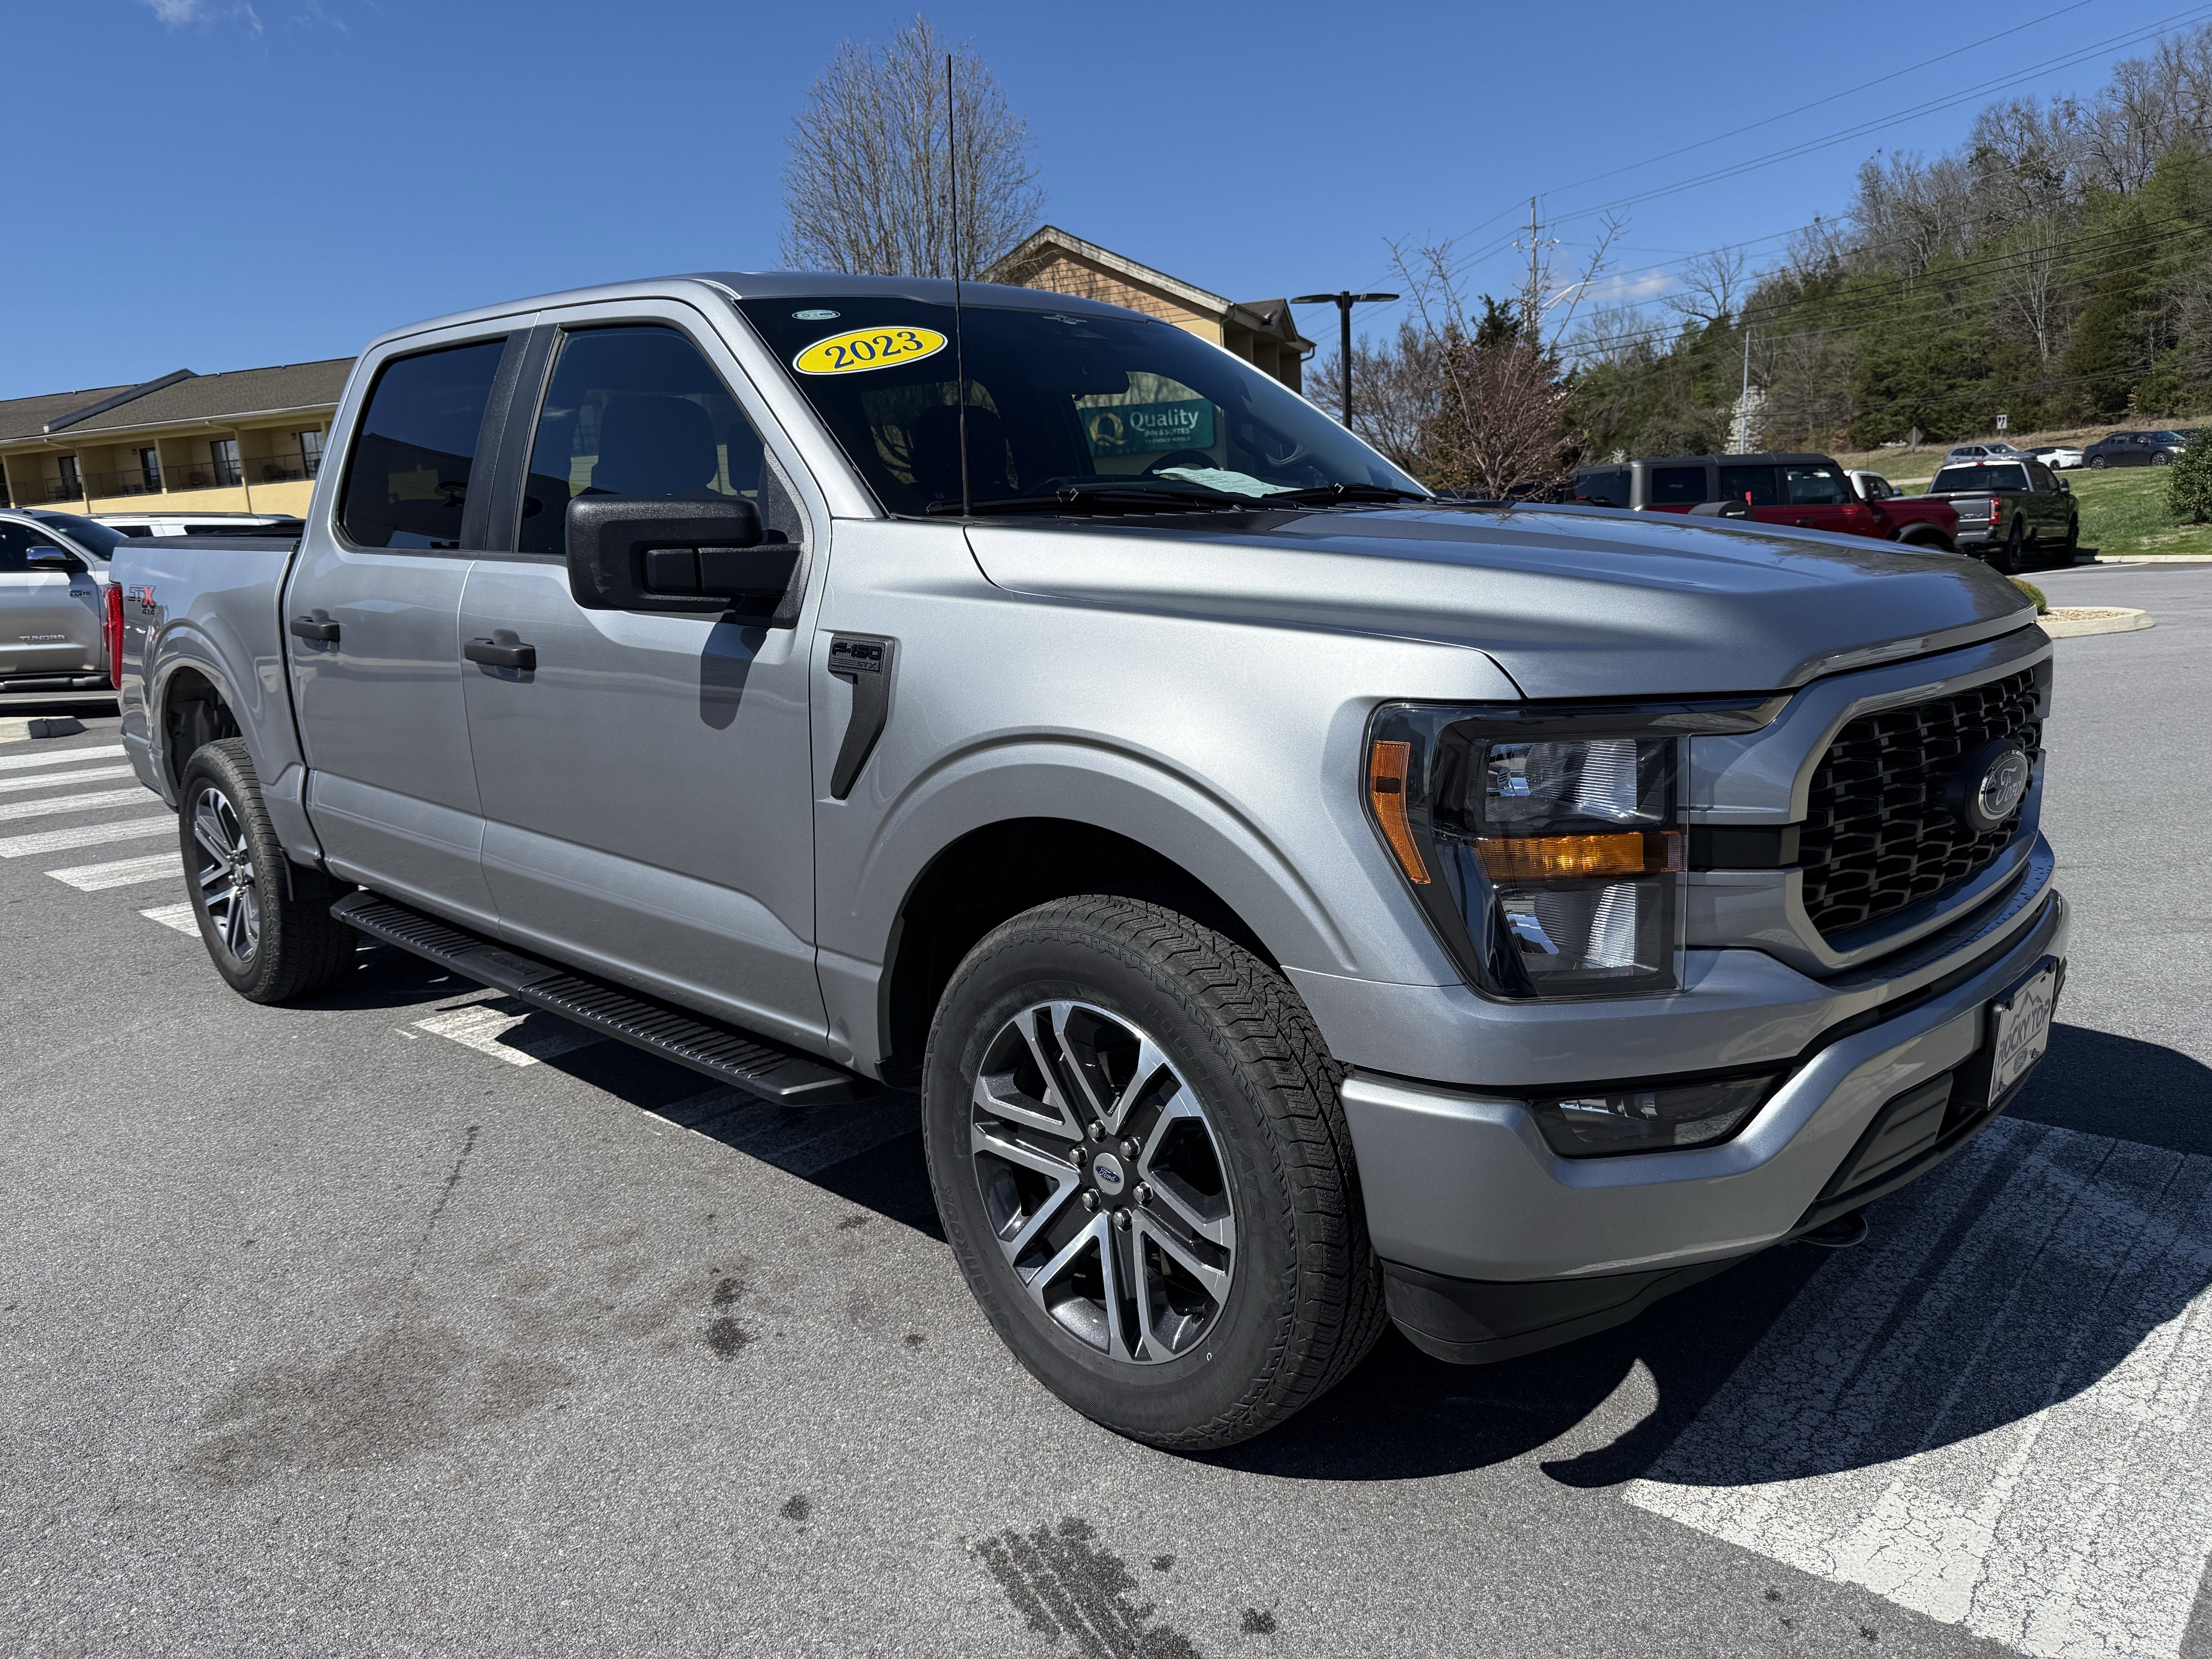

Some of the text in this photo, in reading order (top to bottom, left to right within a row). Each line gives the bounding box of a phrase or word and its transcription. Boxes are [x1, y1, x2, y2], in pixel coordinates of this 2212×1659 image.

[825, 331, 923, 369] 2023
[1130, 409, 1199, 431] Quality
[128, 584, 156, 608] STX
[832, 642, 883, 661] F-150
[856, 661, 878, 670] STX
[1996, 766, 2023, 806] Ford
[1997, 998, 2051, 1068] ROCKY TOP
[1099, 1168, 1116, 1182] Ford
[1235, 1146, 1266, 1221] AT2
